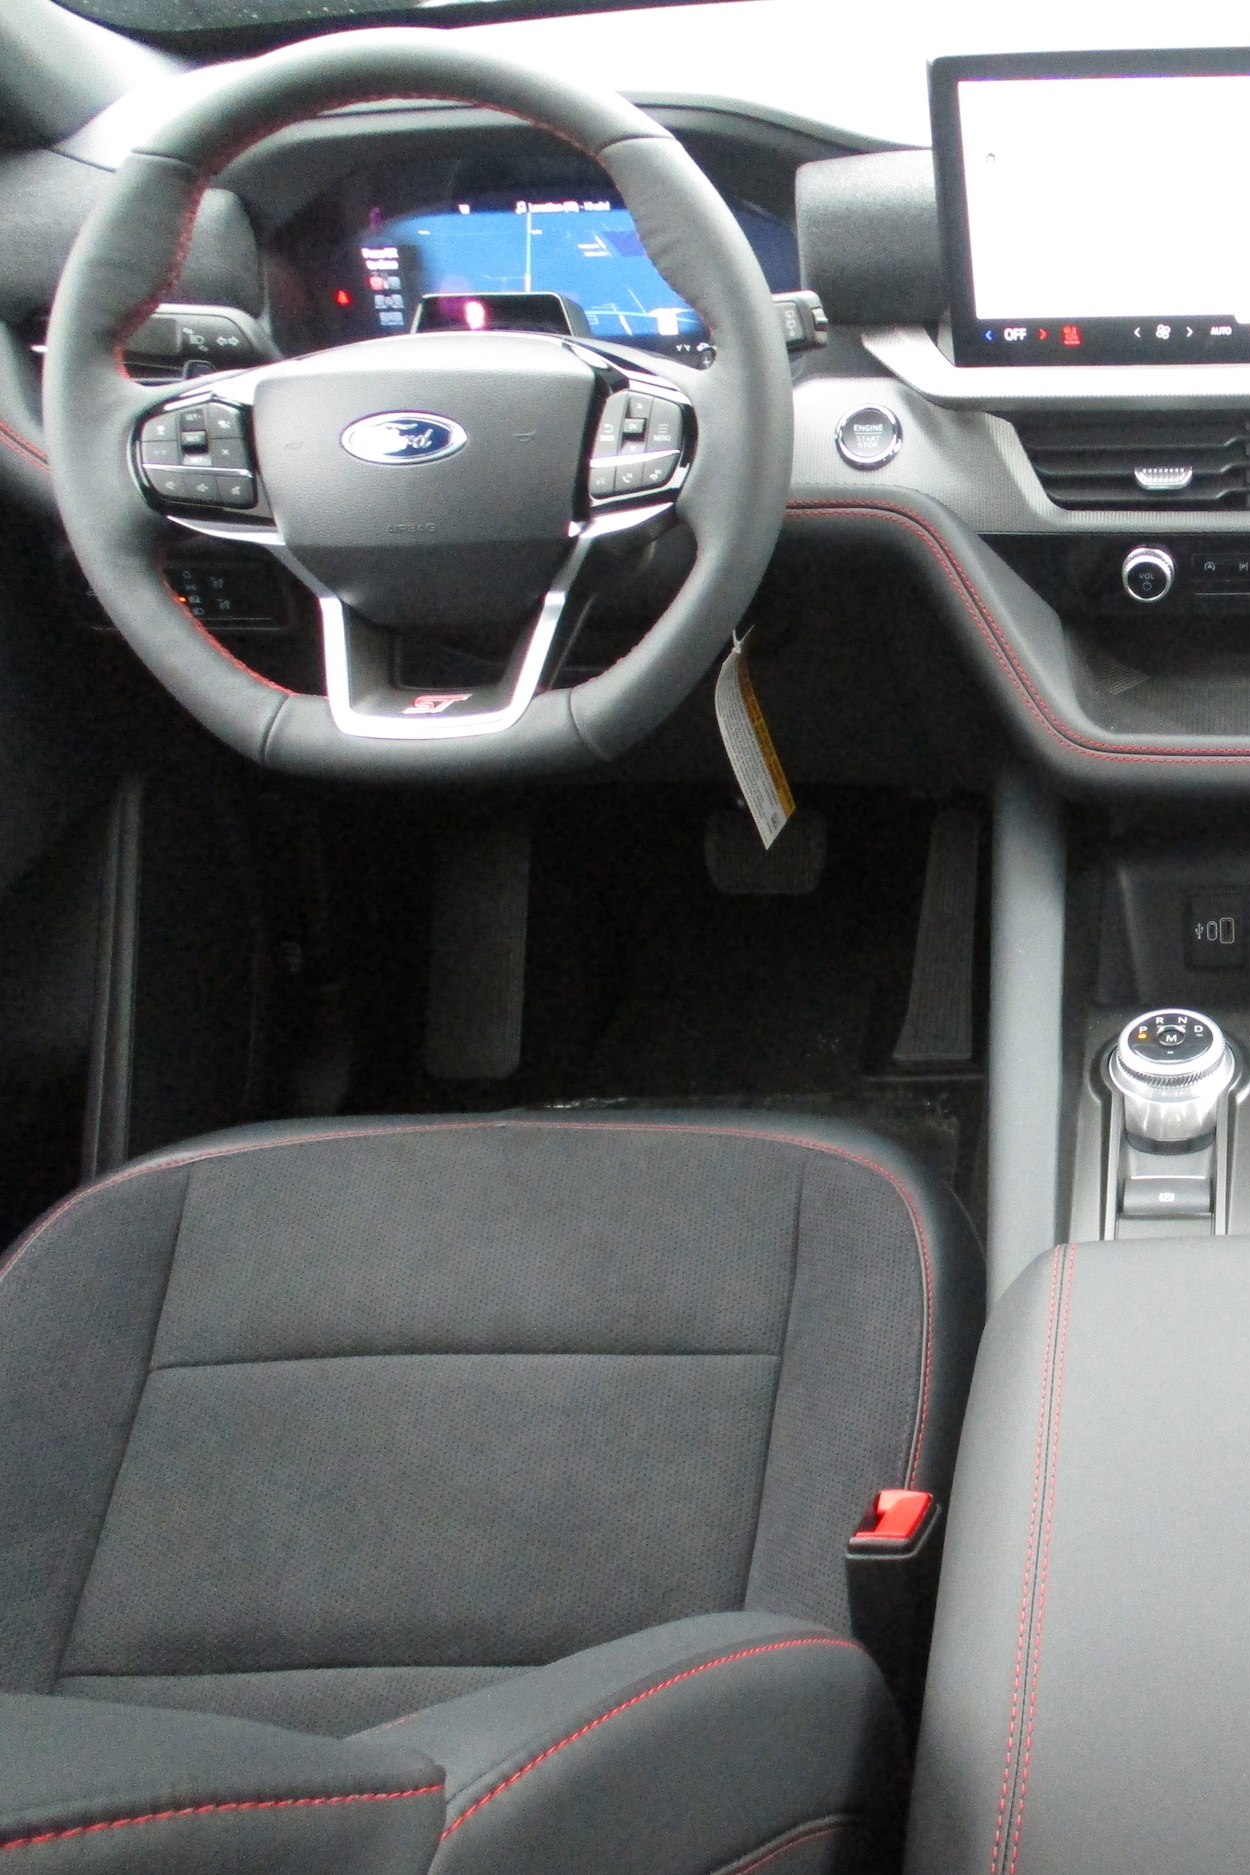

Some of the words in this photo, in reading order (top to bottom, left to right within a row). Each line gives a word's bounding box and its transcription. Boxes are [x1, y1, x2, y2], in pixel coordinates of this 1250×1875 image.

[1004, 328, 1027, 341] OFF
[1210, 326, 1232, 336] AUTO
[853, 423, 883, 431] ENGINE
[653, 434, 672, 442] MENU
[1139, 572, 1155, 580] VOL
[402, 693, 473, 715] ST
[1139, 1026, 1148, 1034] P
[1155, 1016, 1164, 1024] R
[1177, 1016, 1187, 1024] N
[1194, 1025, 1204, 1033] D
[1165, 1034, 1177, 1042] M
